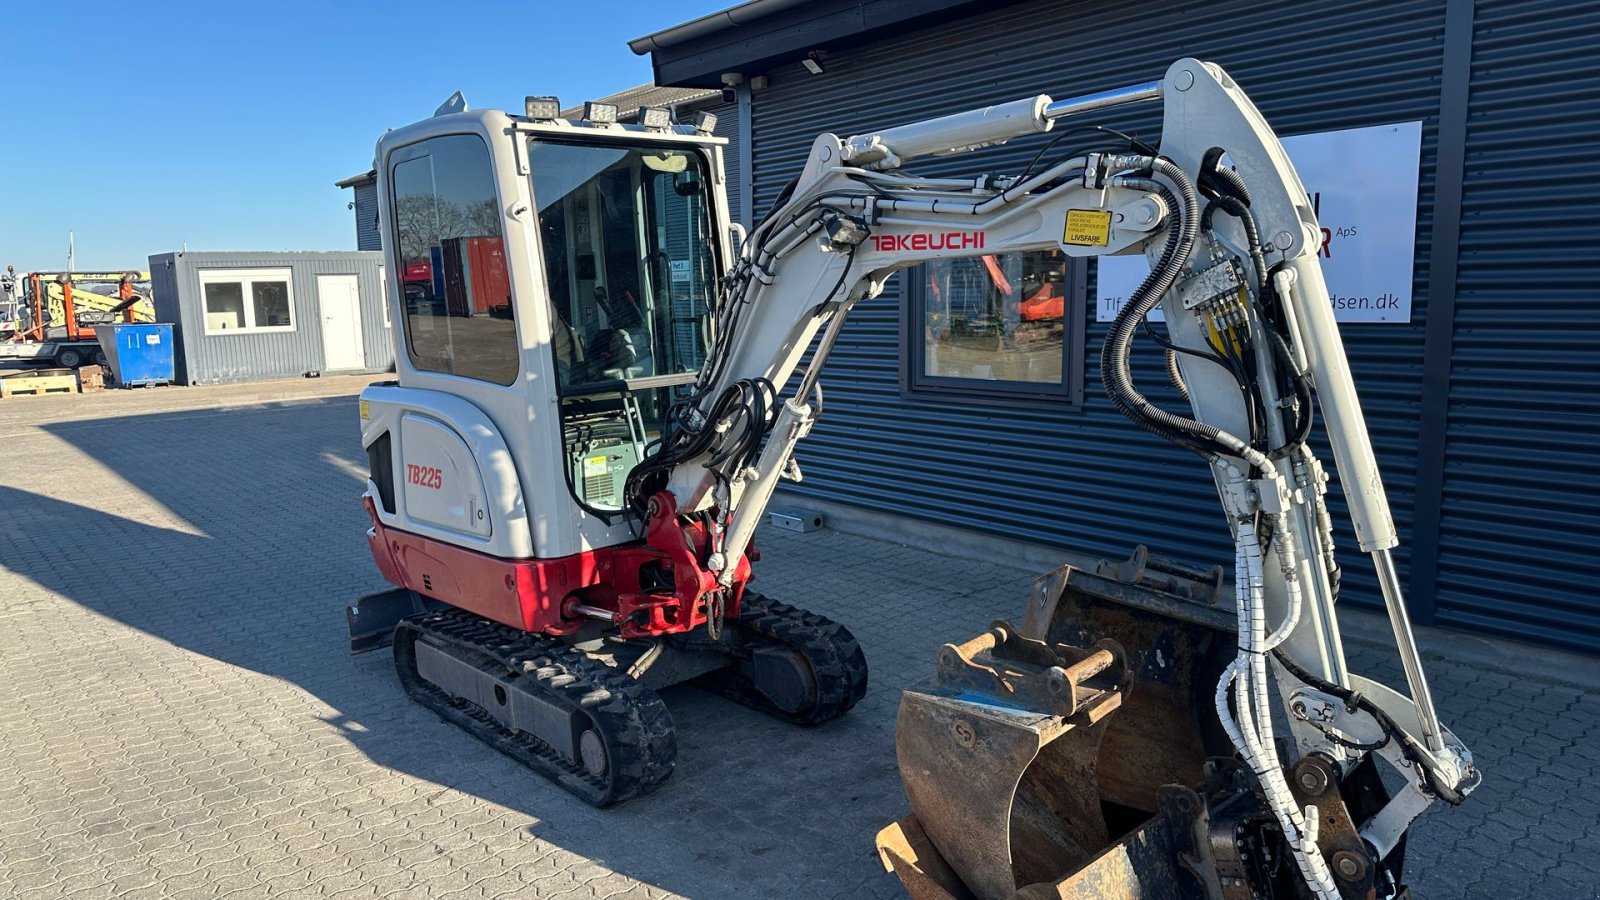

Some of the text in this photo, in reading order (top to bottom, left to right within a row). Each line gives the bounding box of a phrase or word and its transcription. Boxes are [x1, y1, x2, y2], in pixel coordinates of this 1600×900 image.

[1071, 234, 1101, 243] LIVSFARE
[1336, 227, 1357, 238] ApS
[870, 231, 985, 251] TAKEUCHI
[407, 463, 442, 489] TB225
